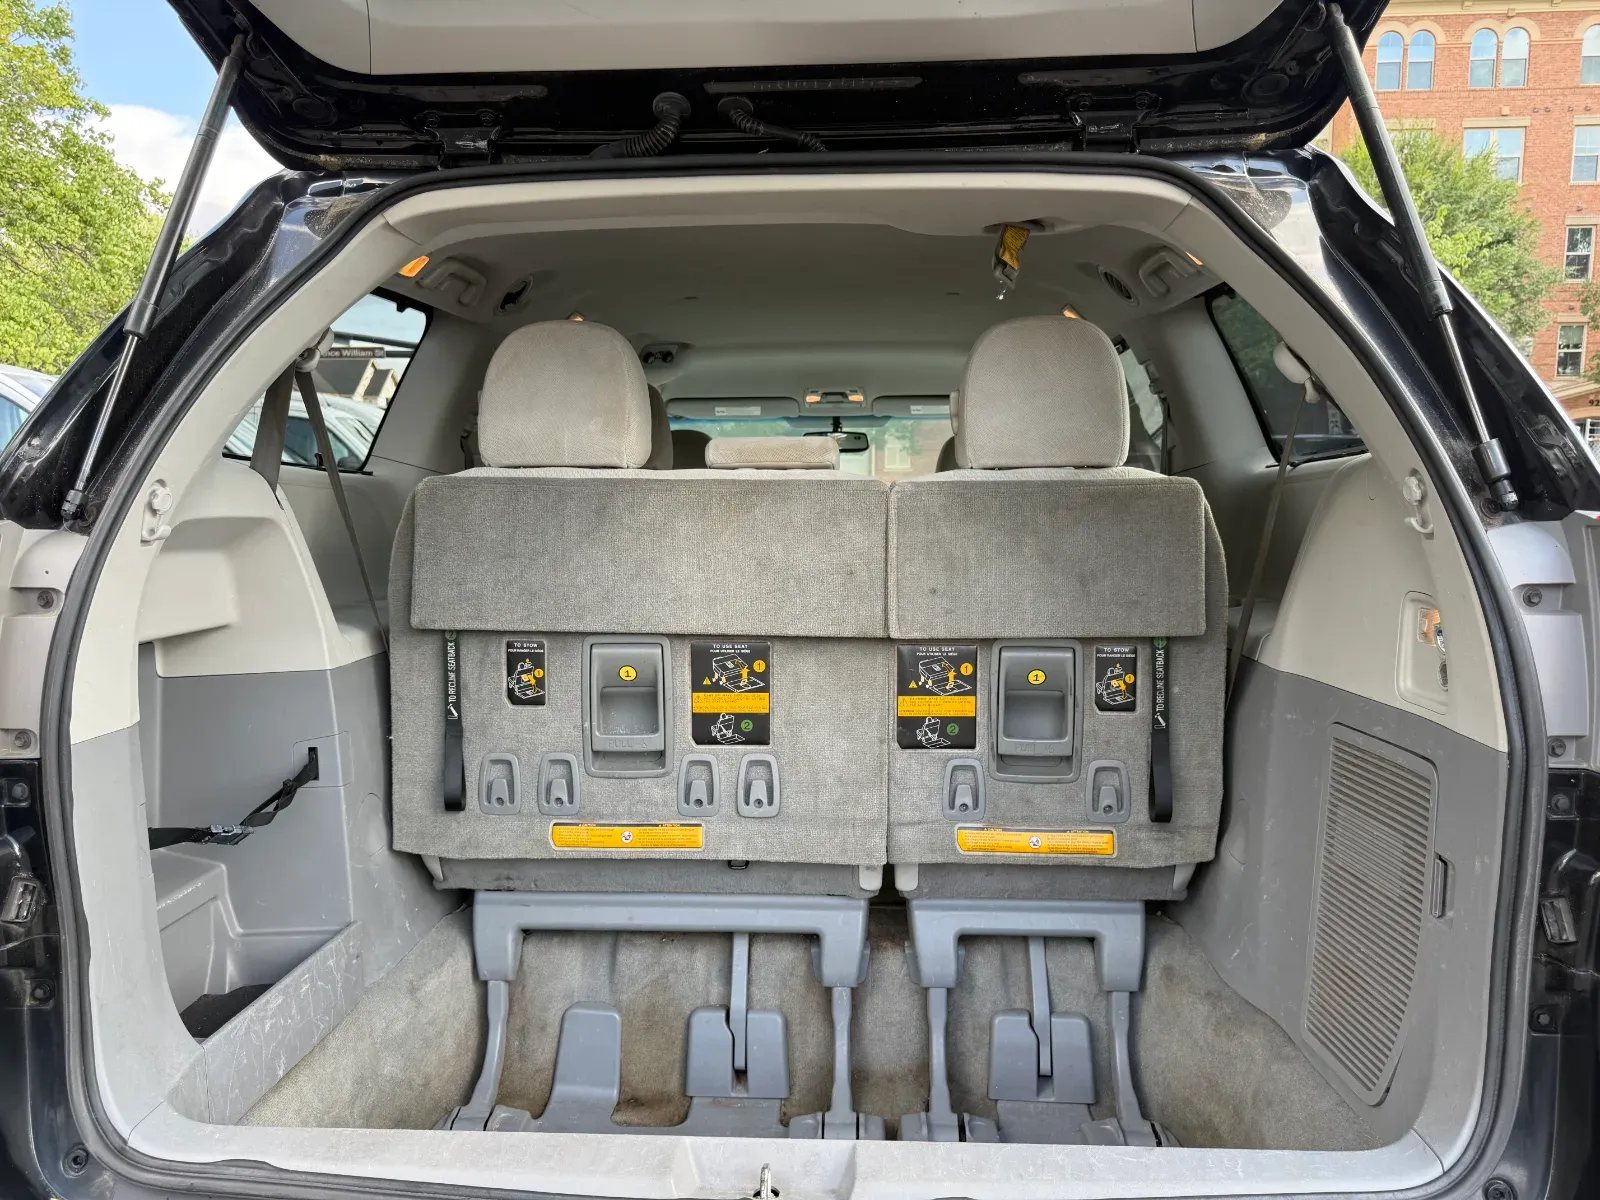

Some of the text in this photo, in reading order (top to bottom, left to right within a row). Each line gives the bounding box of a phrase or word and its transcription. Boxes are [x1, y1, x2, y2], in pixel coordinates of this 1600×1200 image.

[341, 349, 373, 357] William
[374, 349, 384, 357] St
[447, 642, 456, 670] SEATBACK
[1156, 649, 1164, 679] SEATBACK
[624, 670, 632, 678] 1
[1032, 673, 1040, 682] 1
[448, 672, 457, 694] RECLINE
[1156, 679, 1164, 703] RECLINE
[1156, 703, 1164, 711] TO
[744, 721, 750, 730] 2
[949, 725, 956, 733] 2
[608, 740, 632, 748] PULL
